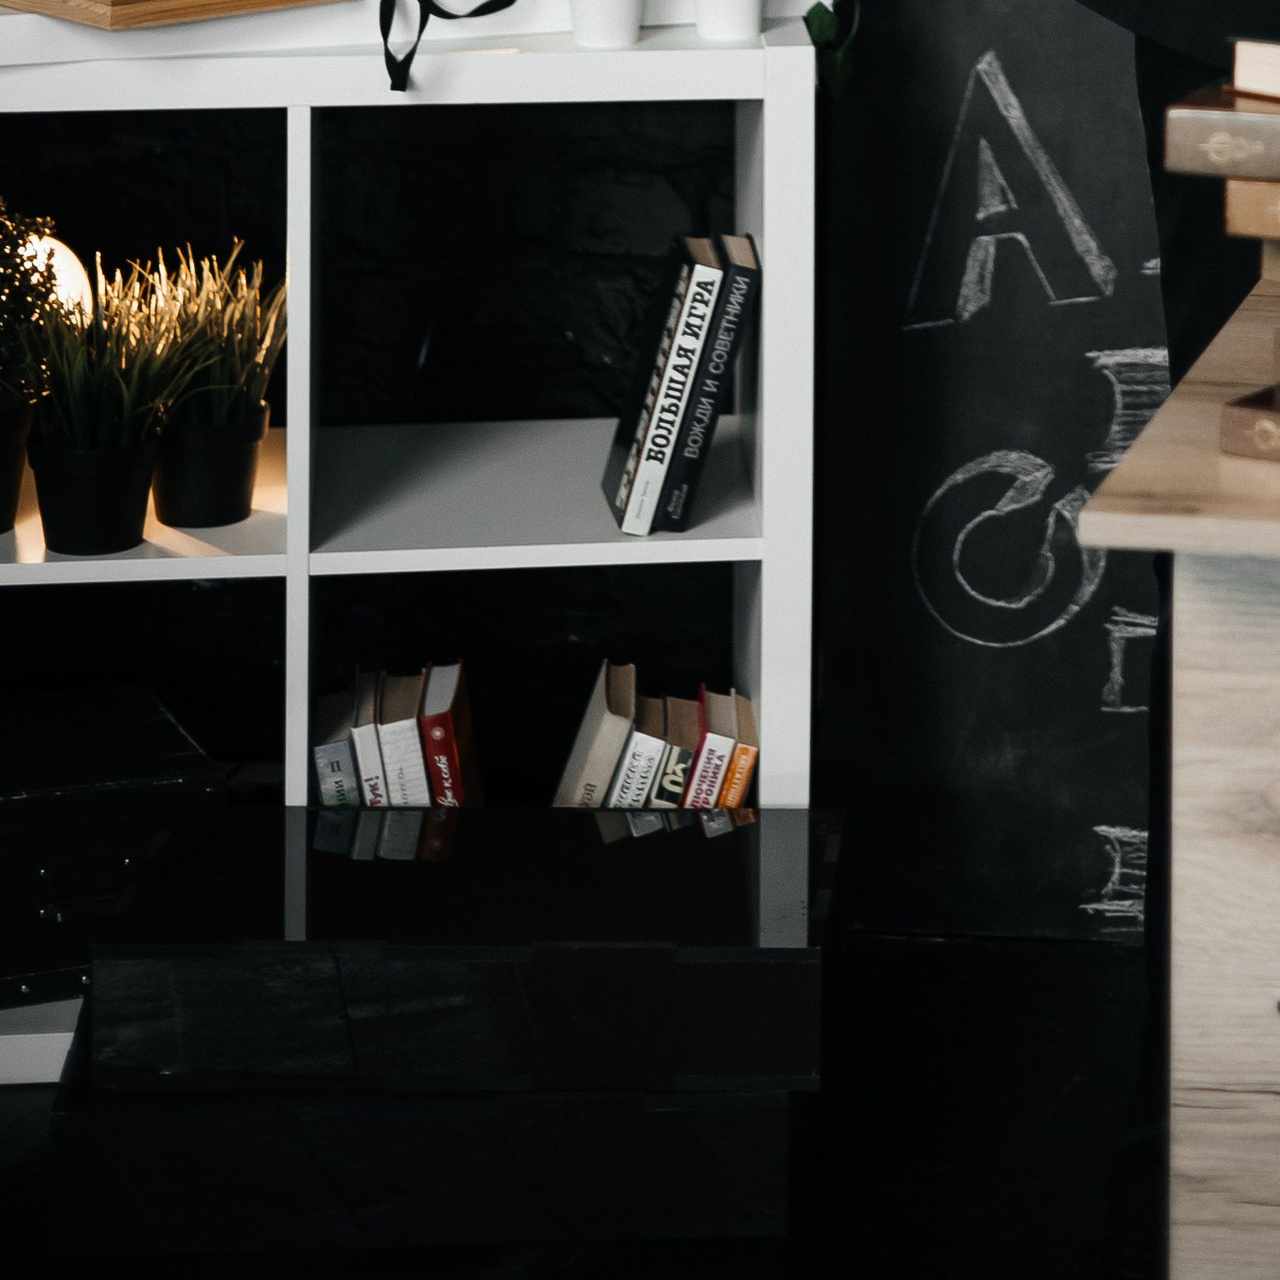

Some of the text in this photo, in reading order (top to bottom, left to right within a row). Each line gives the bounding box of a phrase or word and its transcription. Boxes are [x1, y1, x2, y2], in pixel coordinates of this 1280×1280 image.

[646, 277, 716, 466] БОЛЬШАЯ ИГРА
[684, 274, 750, 459] ВОЖДИ И СОВЕТНИКИ
